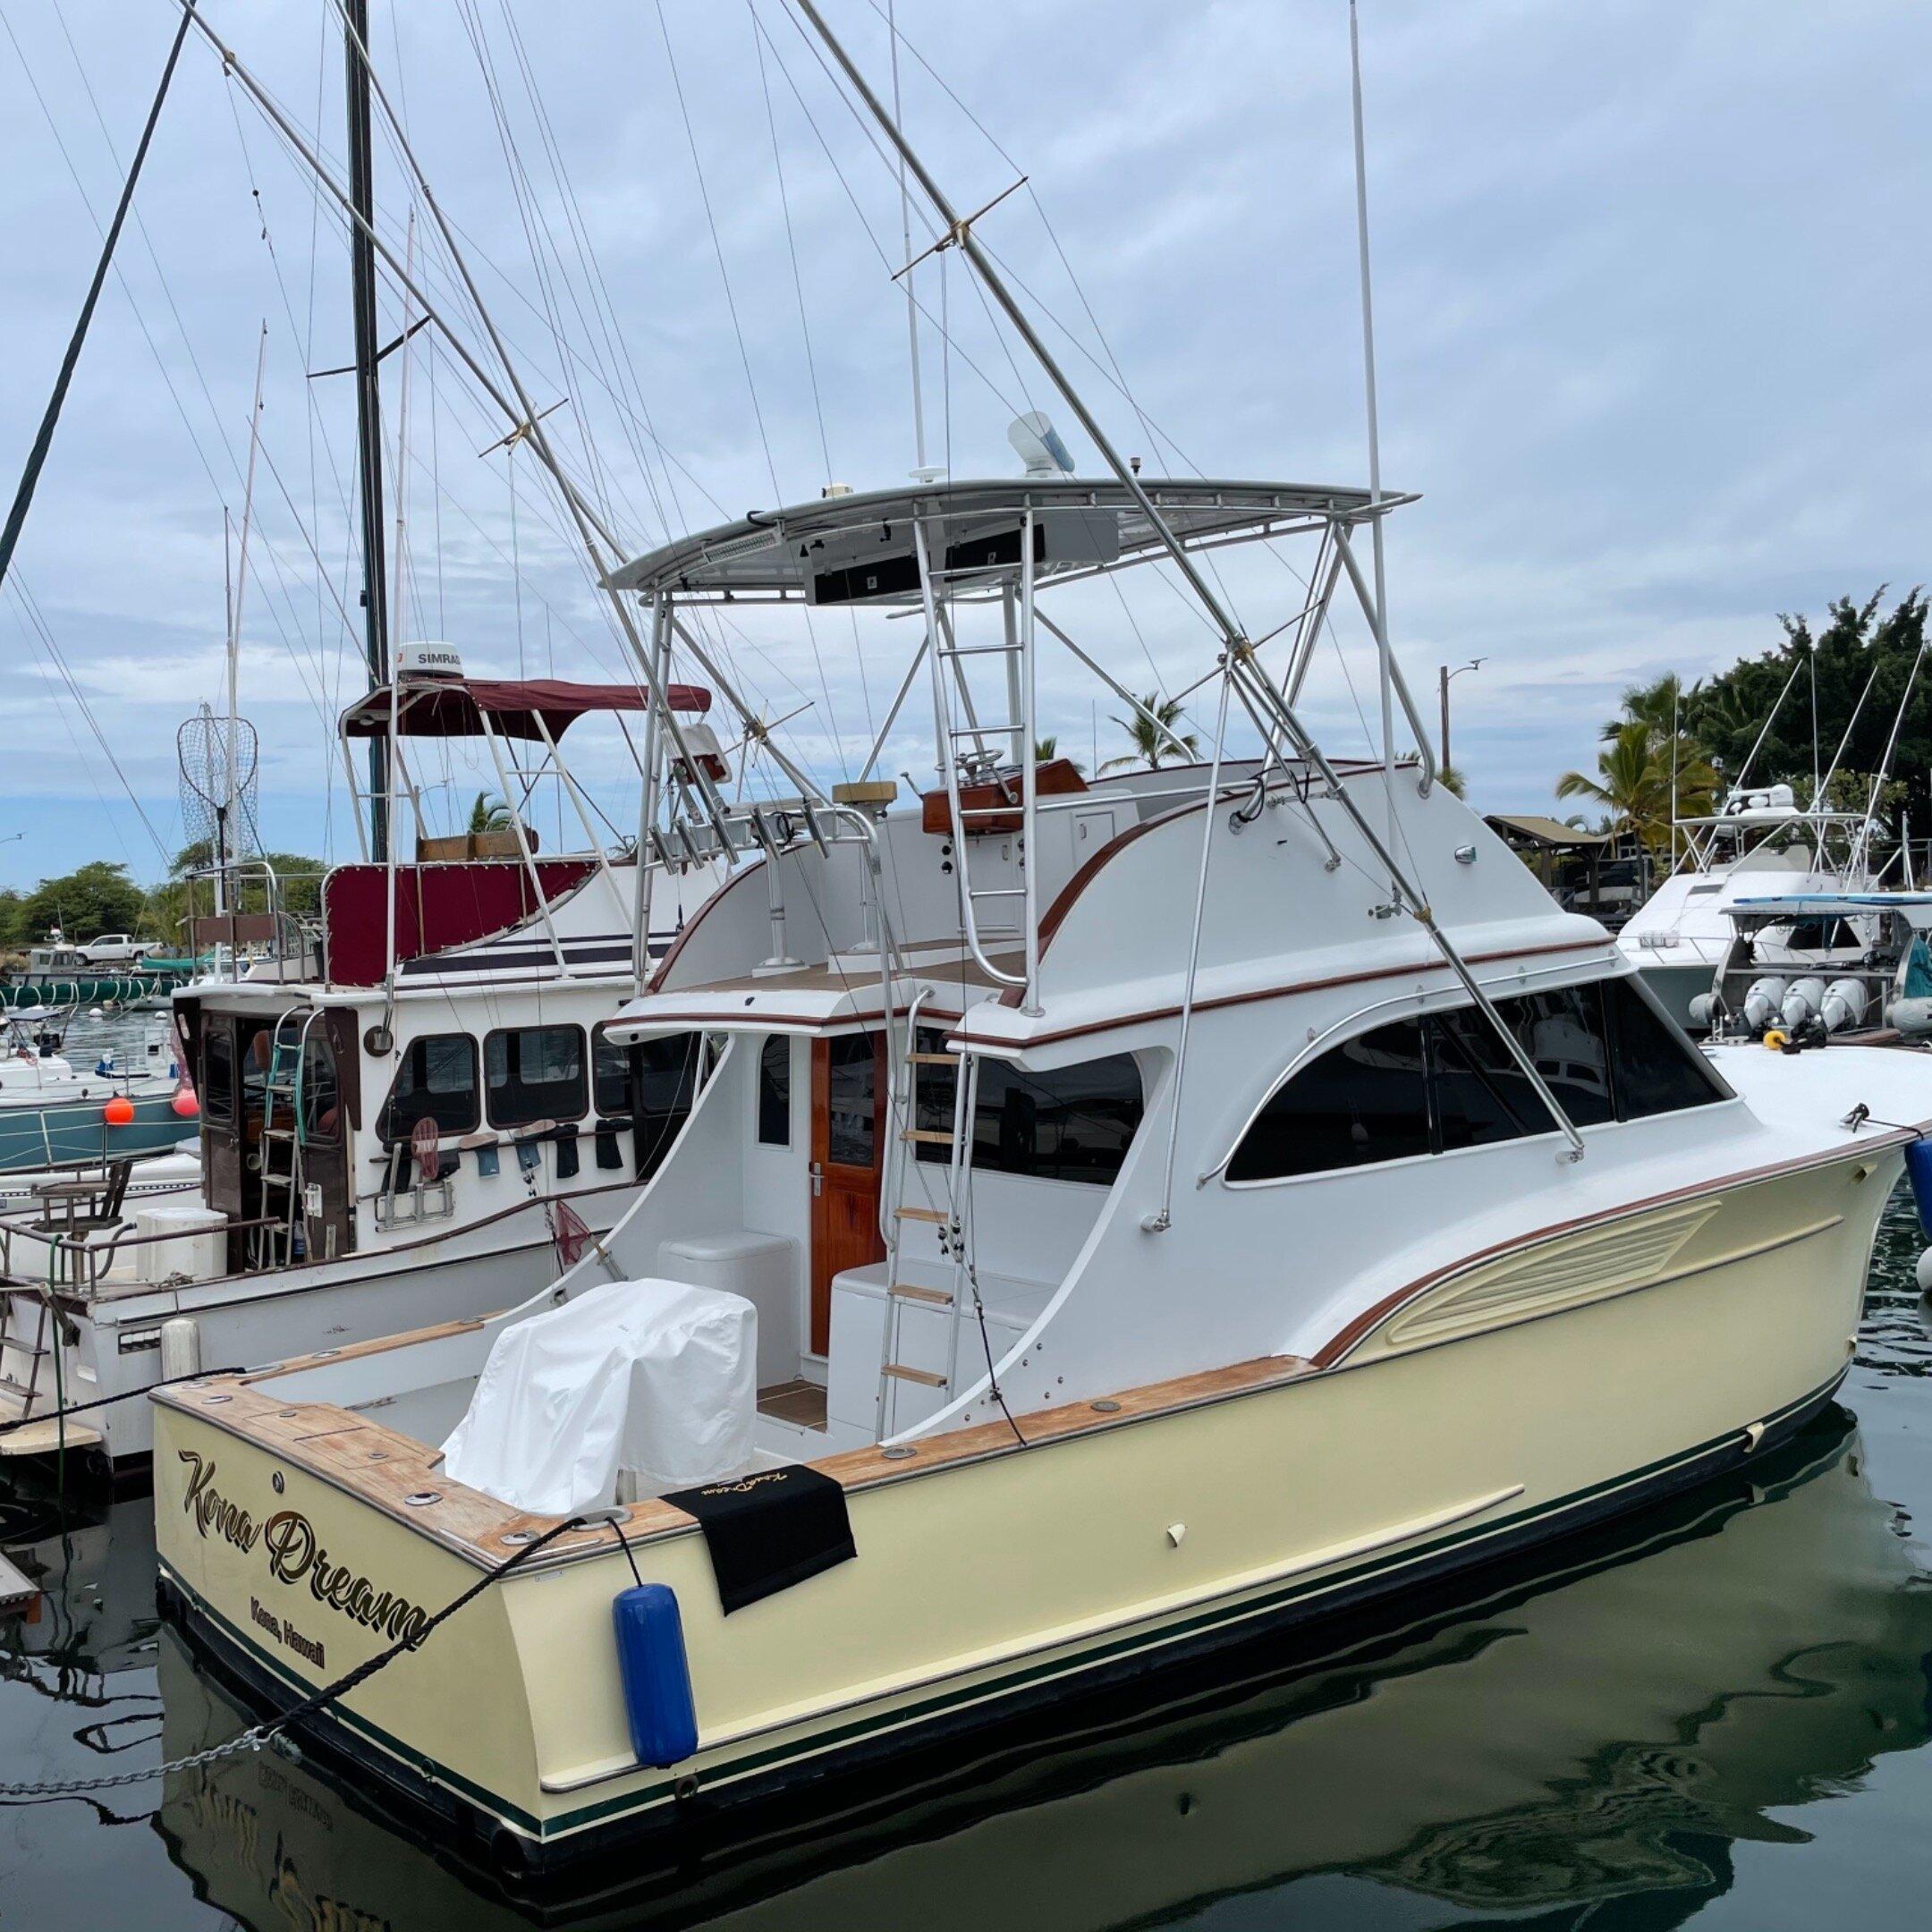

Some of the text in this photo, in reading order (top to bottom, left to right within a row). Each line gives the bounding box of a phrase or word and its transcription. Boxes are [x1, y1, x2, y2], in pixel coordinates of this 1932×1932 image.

[178, 1449, 434, 1653] Kona Dream
[250, 1595, 283, 1645] Kona,
